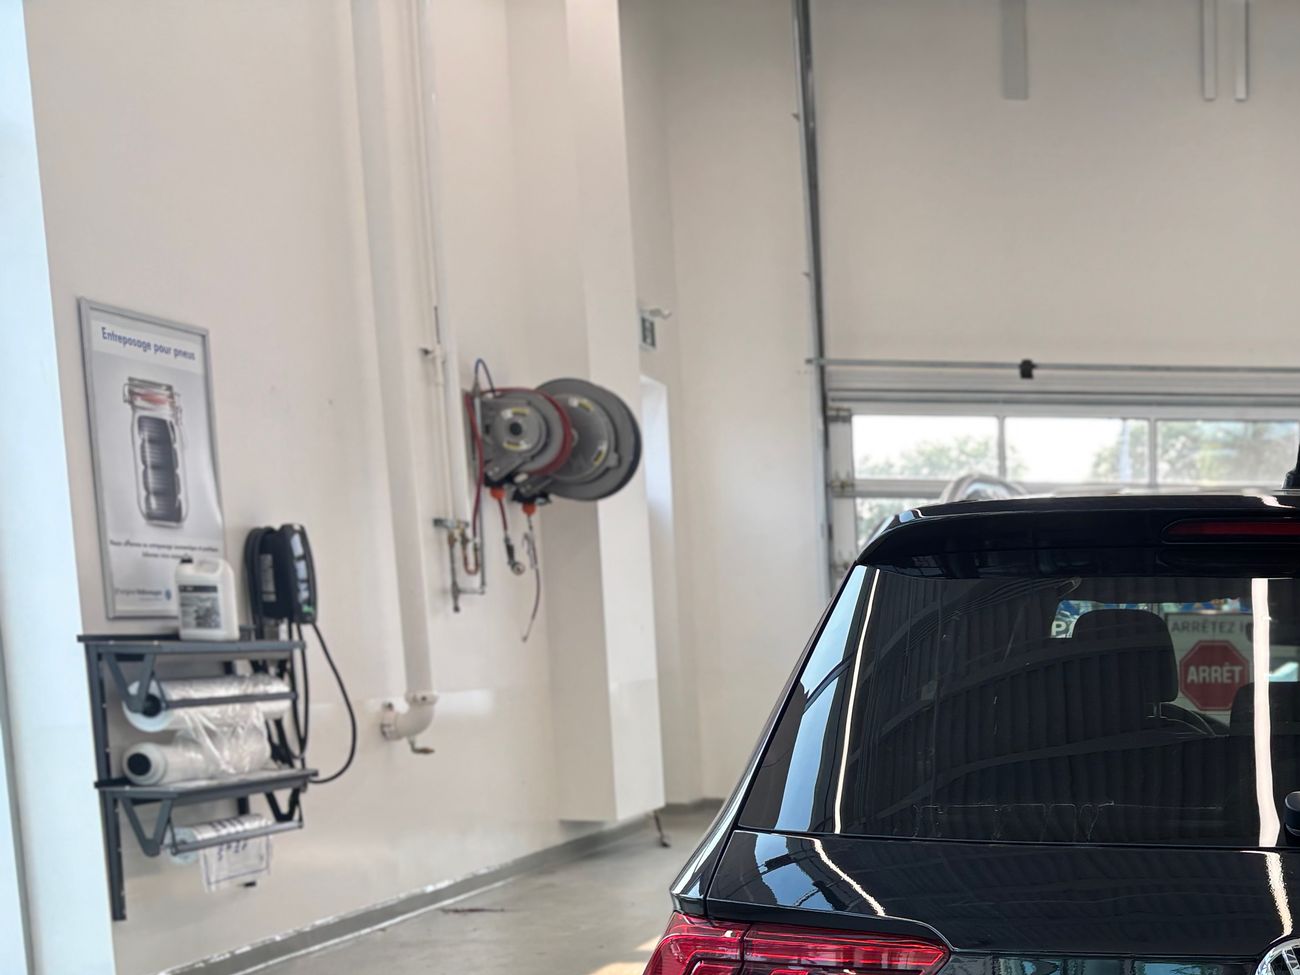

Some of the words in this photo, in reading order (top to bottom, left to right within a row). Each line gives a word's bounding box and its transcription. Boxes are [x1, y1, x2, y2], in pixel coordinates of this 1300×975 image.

[101, 325, 152, 352] Entreposage
[154, 342, 172, 354] pour
[174, 347, 196, 361] pneus
[1186, 661, 1243, 684] ARRÊT
